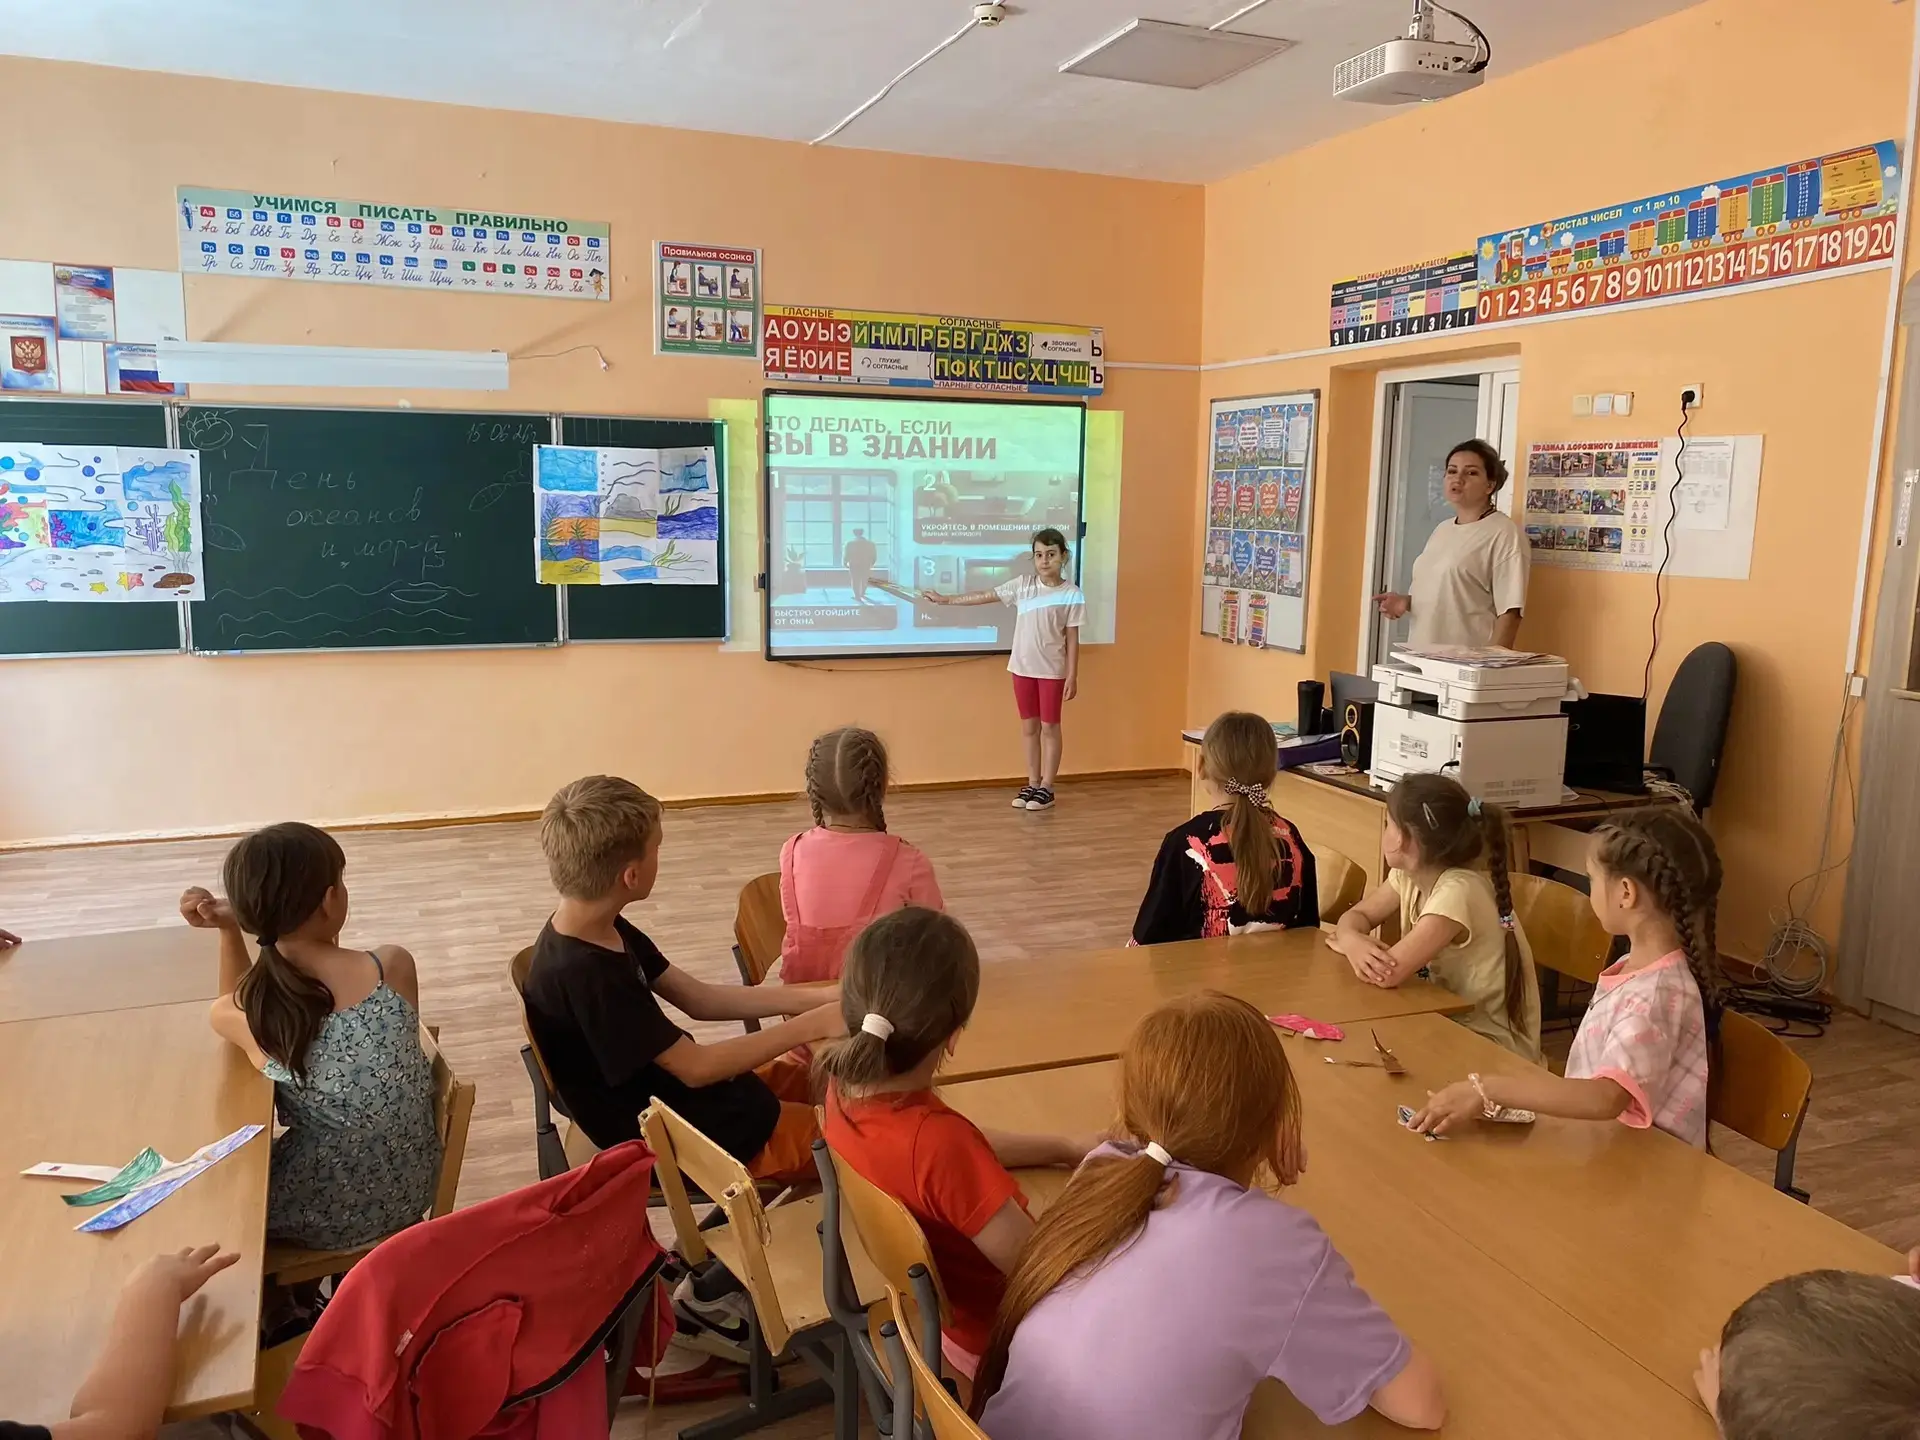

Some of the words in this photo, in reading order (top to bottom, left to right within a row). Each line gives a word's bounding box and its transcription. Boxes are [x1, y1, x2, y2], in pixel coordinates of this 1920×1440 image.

[253, 195, 336, 215] УЧИМСЯ
[359, 204, 437, 222] ПИСАТЬ
[456, 212, 568, 232] ПРАВИЛЬНО
[1553, 217, 1588, 232] СОСТАВ
[1591, 209, 1622, 223] ЧИСЕЛ
[1633, 206, 1642, 214] от
[1646, 202, 1650, 211] 1
[1654, 200, 1665, 210] до
[1669, 195, 1680, 205] 10
[664, 246, 717, 258] Правильная
[719, 251, 752, 261] осанка
[1479, 295, 1491, 319] 0
[1495, 293, 1503, 316] 1
[1507, 290, 1520, 316] 2
[1523, 287, 1535, 312] 3
[1538, 284, 1551, 309] 4
[1555, 280, 1567, 307] 5
[1571, 277, 1585, 304] 6
[1590, 274, 1603, 301] 7
[1606, 271, 1621, 298] 8
[1626, 268, 1640, 295] 9
[1645, 264, 1662, 292] 10
[1665, 260, 1682, 290] 11
[1684, 256, 1704, 286] 12
[1705, 253, 1725, 282] 13
[1726, 248, 1745, 279] 14
[1749, 244, 1769, 275] 15
[1771, 239, 1792, 271] 16
[1794, 235, 1818, 267] 17
[1819, 230, 1842, 263] 18
[1844, 225, 1867, 259] 19
[1869, 221, 1895, 256] 20
[782, 307, 834, 319] ГЛАСНЫЕ
[940, 317, 1001, 329] СОГЛАСНЫЕ
[1334, 333, 1339, 345] 9
[1348, 330, 1354, 343] 8
[1364, 327, 1369, 341] 7
[1381, 325, 1386, 338] 6
[1395, 322, 1401, 336] 5
[1412, 320, 1417, 333] 4
[1428, 317, 1434, 331] 3
[1446, 314, 1452, 328] 2
[1464, 311, 1469, 326] 1
[939, 381, 973, 389] ПАРНЫЕ
[975, 383, 1023, 391] СОГЛАСНЫЕ
[809, 417, 891, 435] ДЕЛАТЬ,
[900, 419, 952, 435] ЕСЛИ
[768, 432, 812, 455] ВЫ
[828, 435, 849, 455] В
[863, 436, 997, 460] ЗДАНИИ
[1566, 443, 1613, 451] ДОРОЖНОГО
[1615, 441, 1658, 450] ДВИЖЕНИЯ
[772, 471, 780, 489] 1
[923, 474, 936, 491] 2
[286, 486, 421, 527] океанов
[924, 559, 935, 576] 3
[814, 608, 860, 616] ОТОЙДИТЕ
